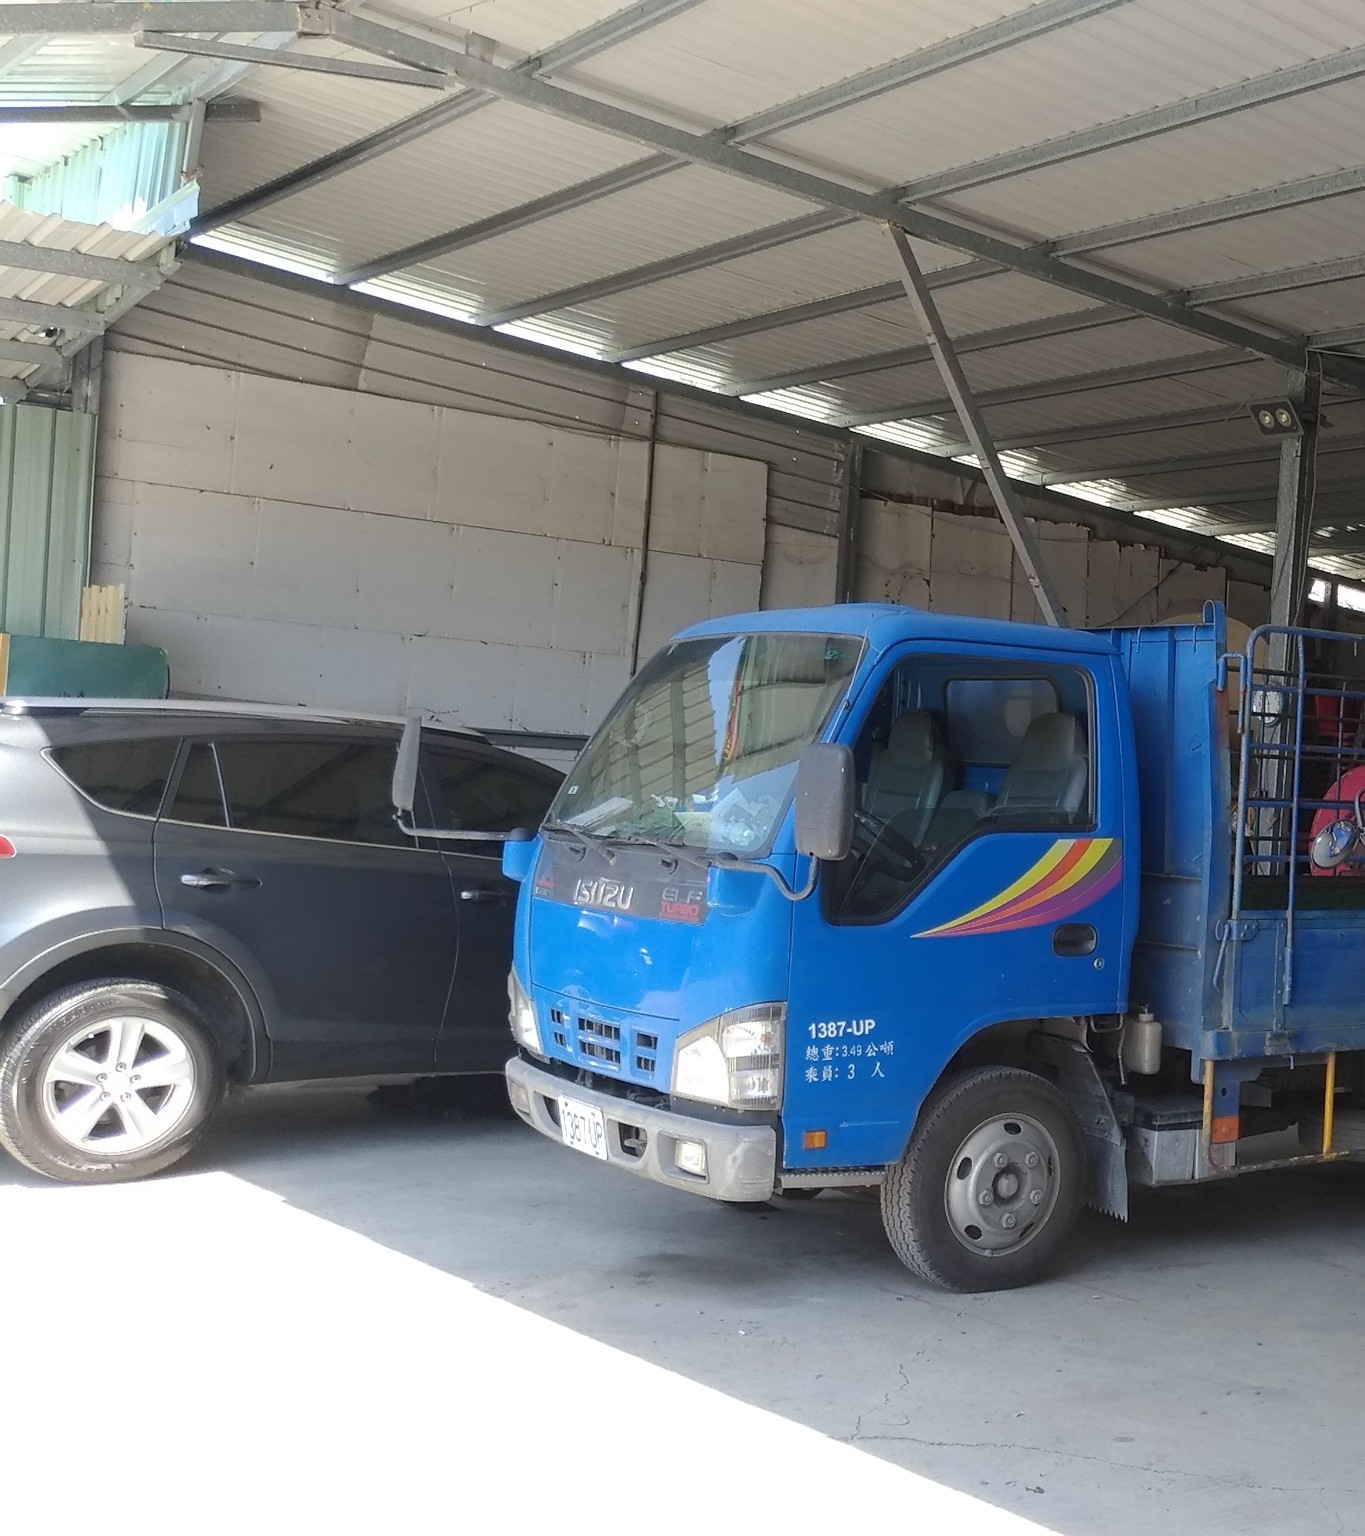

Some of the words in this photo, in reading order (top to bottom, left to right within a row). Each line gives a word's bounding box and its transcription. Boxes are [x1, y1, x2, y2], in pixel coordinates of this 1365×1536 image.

[573, 877, 635, 911] ISUZU
[660, 901, 700, 917] TURBO
[808, 1018, 876, 1040] 1387-UP
[847, 1064, 856, 1080] 3
[870, 1060, 886, 1078] 人
